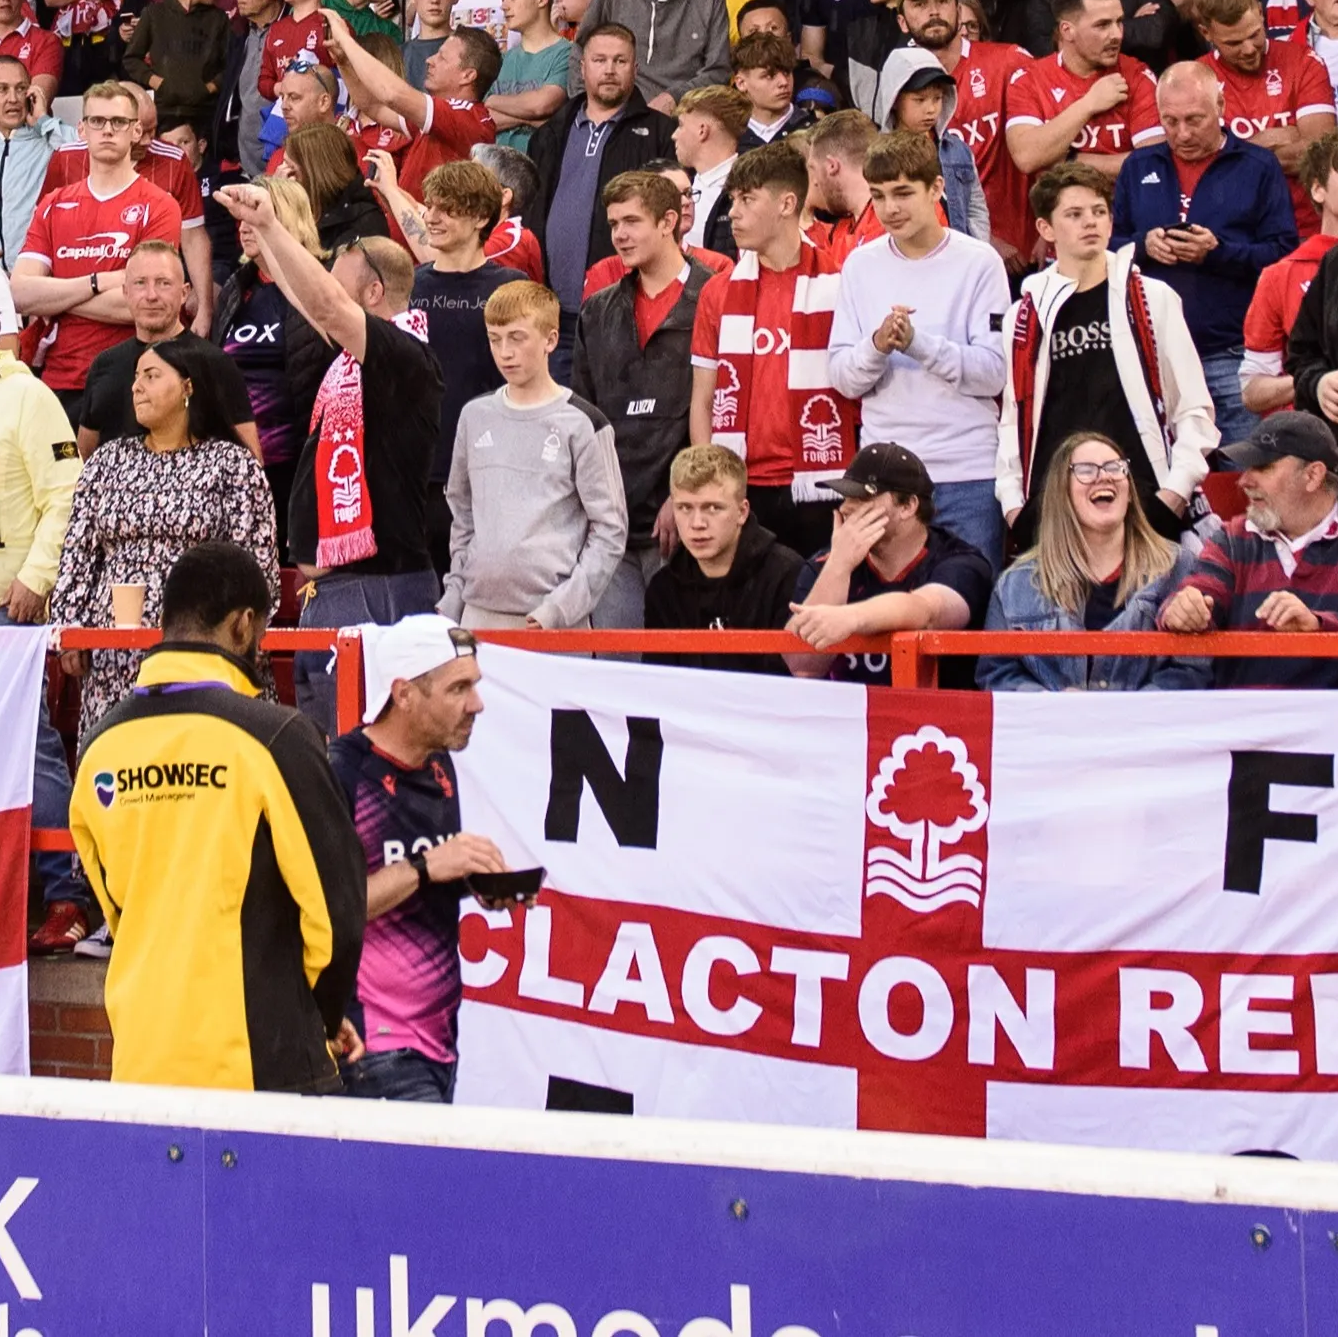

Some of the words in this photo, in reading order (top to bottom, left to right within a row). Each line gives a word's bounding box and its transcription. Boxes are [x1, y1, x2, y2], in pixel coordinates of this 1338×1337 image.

[947, 111, 1000, 147] OXT
[1070, 123, 1125, 149] OXT
[410, 296, 430, 309] vin
[431, 294, 470, 310] Klein
[470, 295, 487, 310] Je
[752, 327, 792, 356] OX
[1052, 321, 1112, 354] BOSS
[711, 413, 737, 429] REST
[802, 450, 844, 464] FOREST
[117, 764, 228, 793] SHOWSEC
[544, 708, 664, 849] N
[1223, 750, 1335, 896] F
[457, 905, 1057, 1071] CLACTON
